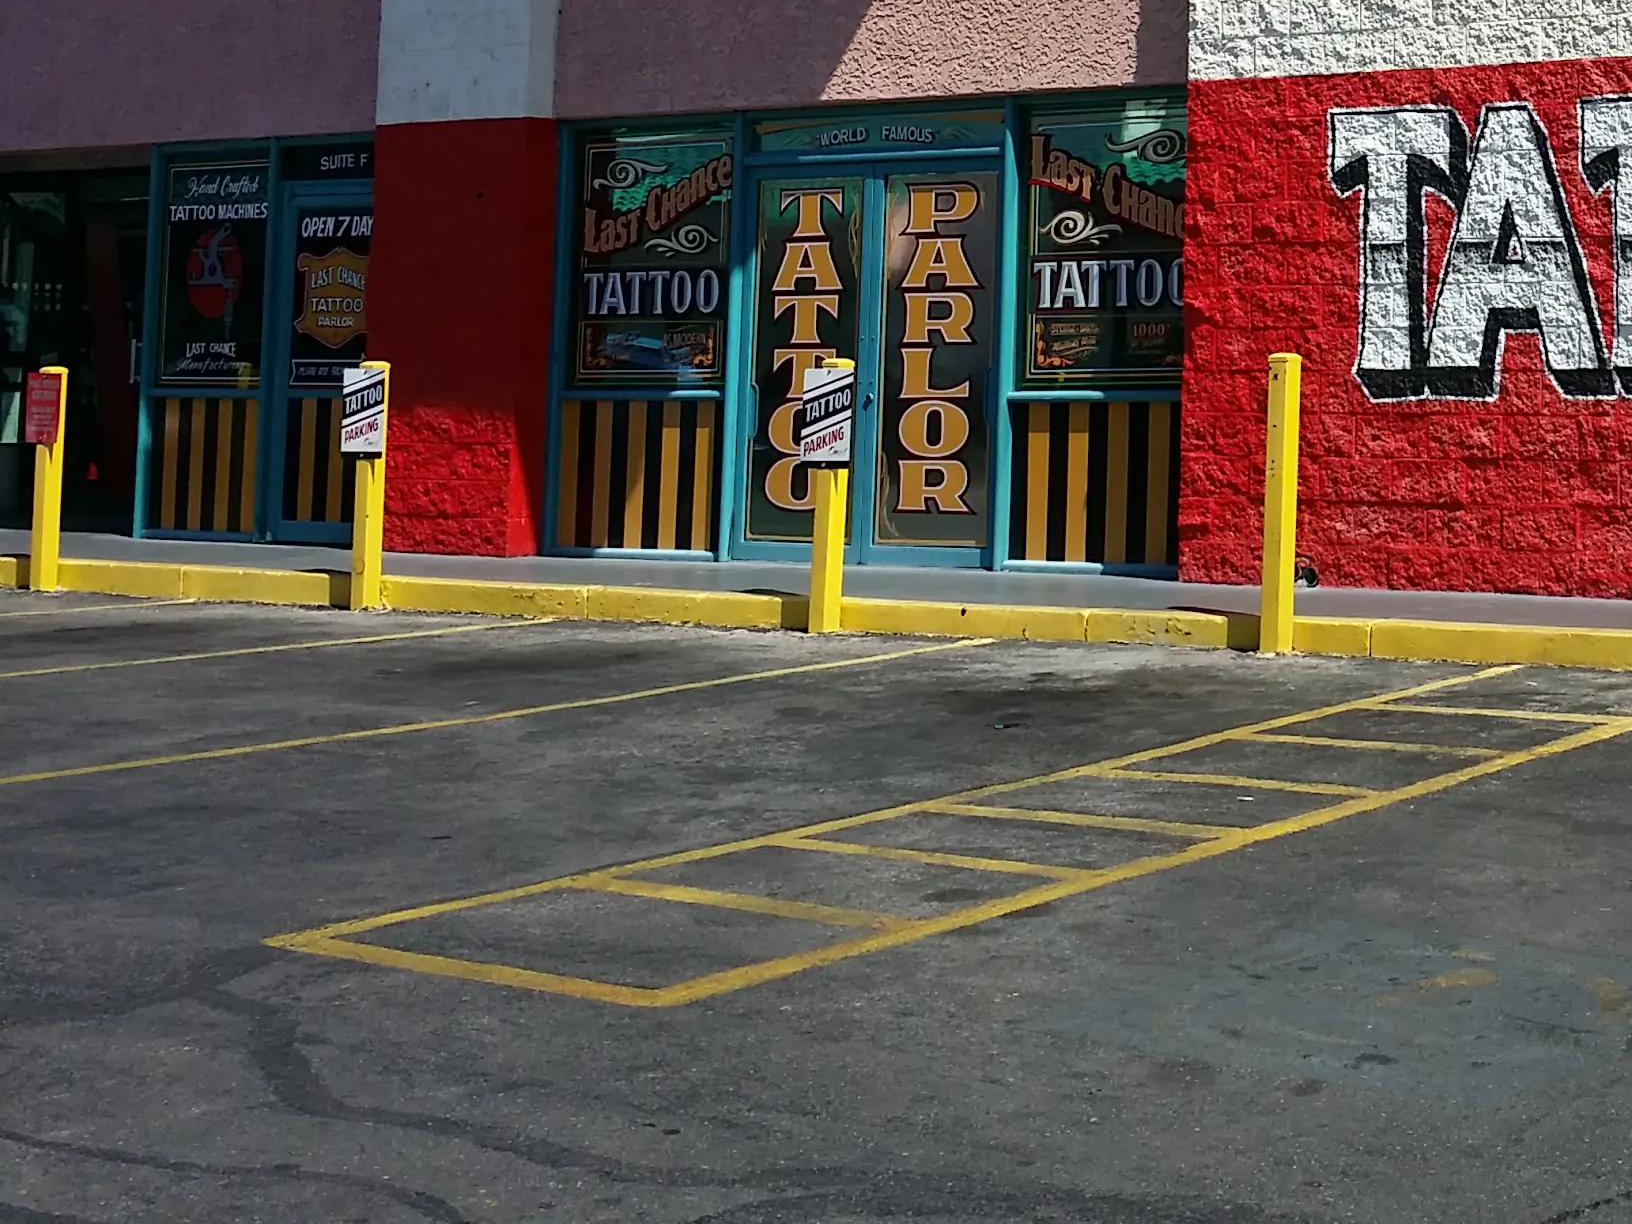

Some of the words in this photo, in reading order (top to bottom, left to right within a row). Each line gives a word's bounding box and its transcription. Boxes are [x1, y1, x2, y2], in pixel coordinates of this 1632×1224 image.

[320, 154, 354, 170] SUITE
[185, 175, 218, 198] Hand
[220, 175, 259, 199] Crafted
[169, 204, 216, 222] TATTOO
[217, 202, 268, 220] MACHINES
[1102, 164, 1186, 238] Chanc
[302, 217, 335, 238] OPEN
[335, 215, 351, 238] 7
[351, 215, 374, 237] DAY
[311, 266, 332, 289] LAST
[1034, 258, 1185, 308] TATTOO
[583, 269, 719, 315] TATTOO
[311, 297, 363, 313] TATTOO
[317, 316, 354, 327] PARLOR
[186, 342, 205, 358] LAST
[209, 342, 237, 358] CHANCE
[896, 182, 982, 514] PARLOR
[344, 384, 383, 415] TATTOO
[805, 388, 851, 423] TATTOO
[344, 418, 379, 444] PARKING
[803, 426, 844, 458] PARKING
